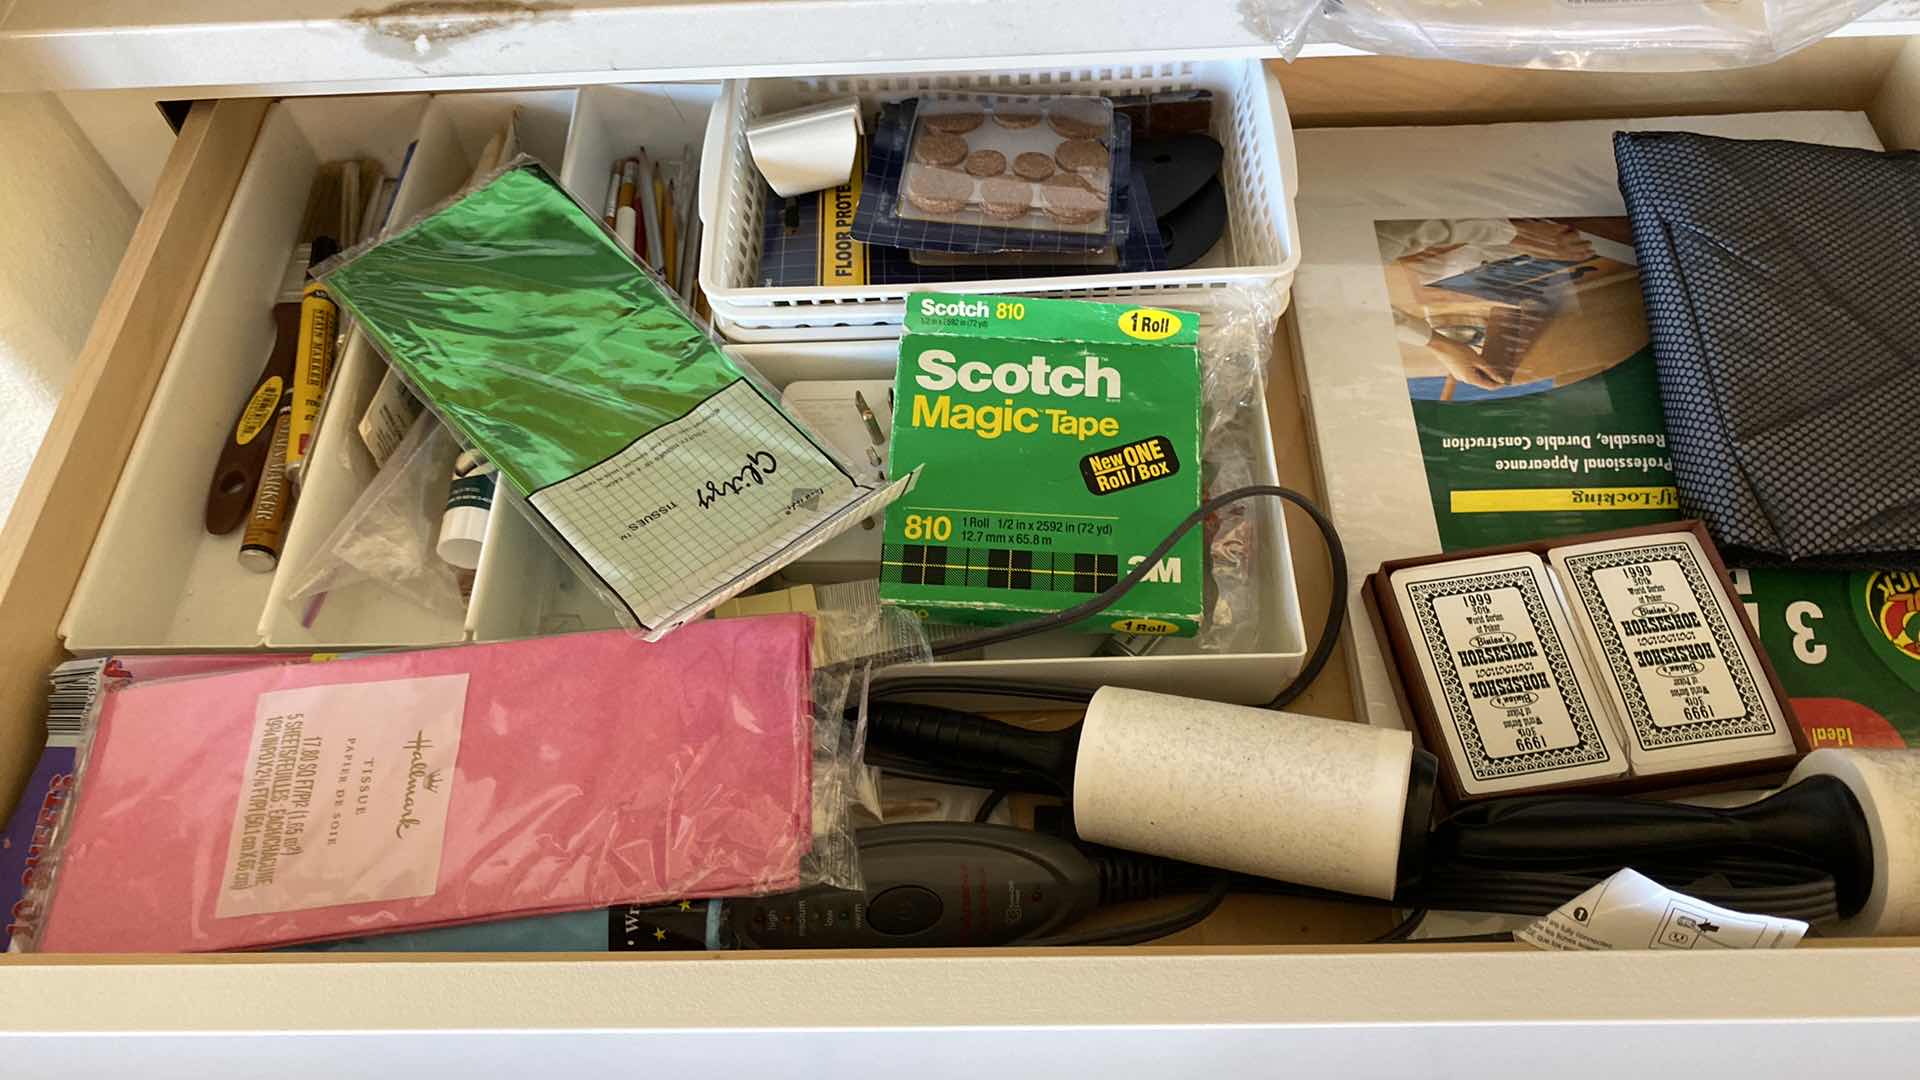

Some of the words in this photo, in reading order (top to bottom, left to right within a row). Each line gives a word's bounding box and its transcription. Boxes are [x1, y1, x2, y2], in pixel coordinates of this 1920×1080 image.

[834, 184, 852, 228] PROTE
[834, 232, 852, 277] FLOOR
[920, 298, 990, 318] Scotch
[996, 302, 1025, 320] 810
[1130, 312, 1139, 332] 1
[1141, 316, 1170, 333] Roll
[914, 348, 1122, 399] Scotch
[911, 394, 1040, 439] Magic
[1045, 408, 1121, 441] Tape
[1442, 434, 1532, 450] Construction
[1536, 434, 1592, 449] Durable
[1596, 433, 1667, 449] Reusable,
[1088, 452, 1125, 475] New
[1121, 440, 1165, 468] ONE
[1495, 458, 1578, 473] Appearance
[1584, 457, 1673, 473] Professional
[255, 460, 286, 522] MARKER
[696, 450, 777, 510] Glitzy
[1572, 487, 1675, 507] lf-Locking
[627, 500, 679, 532] TISSUES
[903, 514, 953, 542] 810
[962, 517, 968, 526] 1
[970, 517, 990, 529] Roll
[998, 519, 1014, 530] 1/2
[1016, 520, 1026, 530] in
[1028, 522, 1035, 531] x
[1036, 521, 1063, 532] 2592
[1065, 522, 1075, 533] in
[1077, 522, 1095, 535] (72
[1096, 523, 1113, 536] yd)
[961, 530, 983, 542] 12.7
[985, 534, 1006, 543] mm
[1008, 535, 1015, 544] x
[1016, 533, 1040, 545] 65.8
[1041, 536, 1053, 545] m
[1622, 565, 1652, 579] 1999
[1463, 592, 1492, 607] 1999
[1123, 621, 1131, 632] 1
[1136, 622, 1168, 634] Roll
[1621, 612, 1702, 637] HORSESHOE
[1785, 600, 1828, 665] 3
[1457, 641, 1538, 668] HORSESHOE
[1633, 642, 1716, 668] HORSESHOE
[1468, 671, 1551, 699] HORSESHOE
[1683, 705, 1715, 721] 1999
[1515, 735, 1547, 752] 1999
[1811, 727, 1854, 746] Ideal
[343, 737, 357, 783] PAPIER
[355, 757, 375, 816] TISSUE
[396, 730, 433, 839] Hallmark
[336, 788, 346, 808] DE
[328, 813, 342, 846] SOIE
[625, 906, 642, 933] Wr
